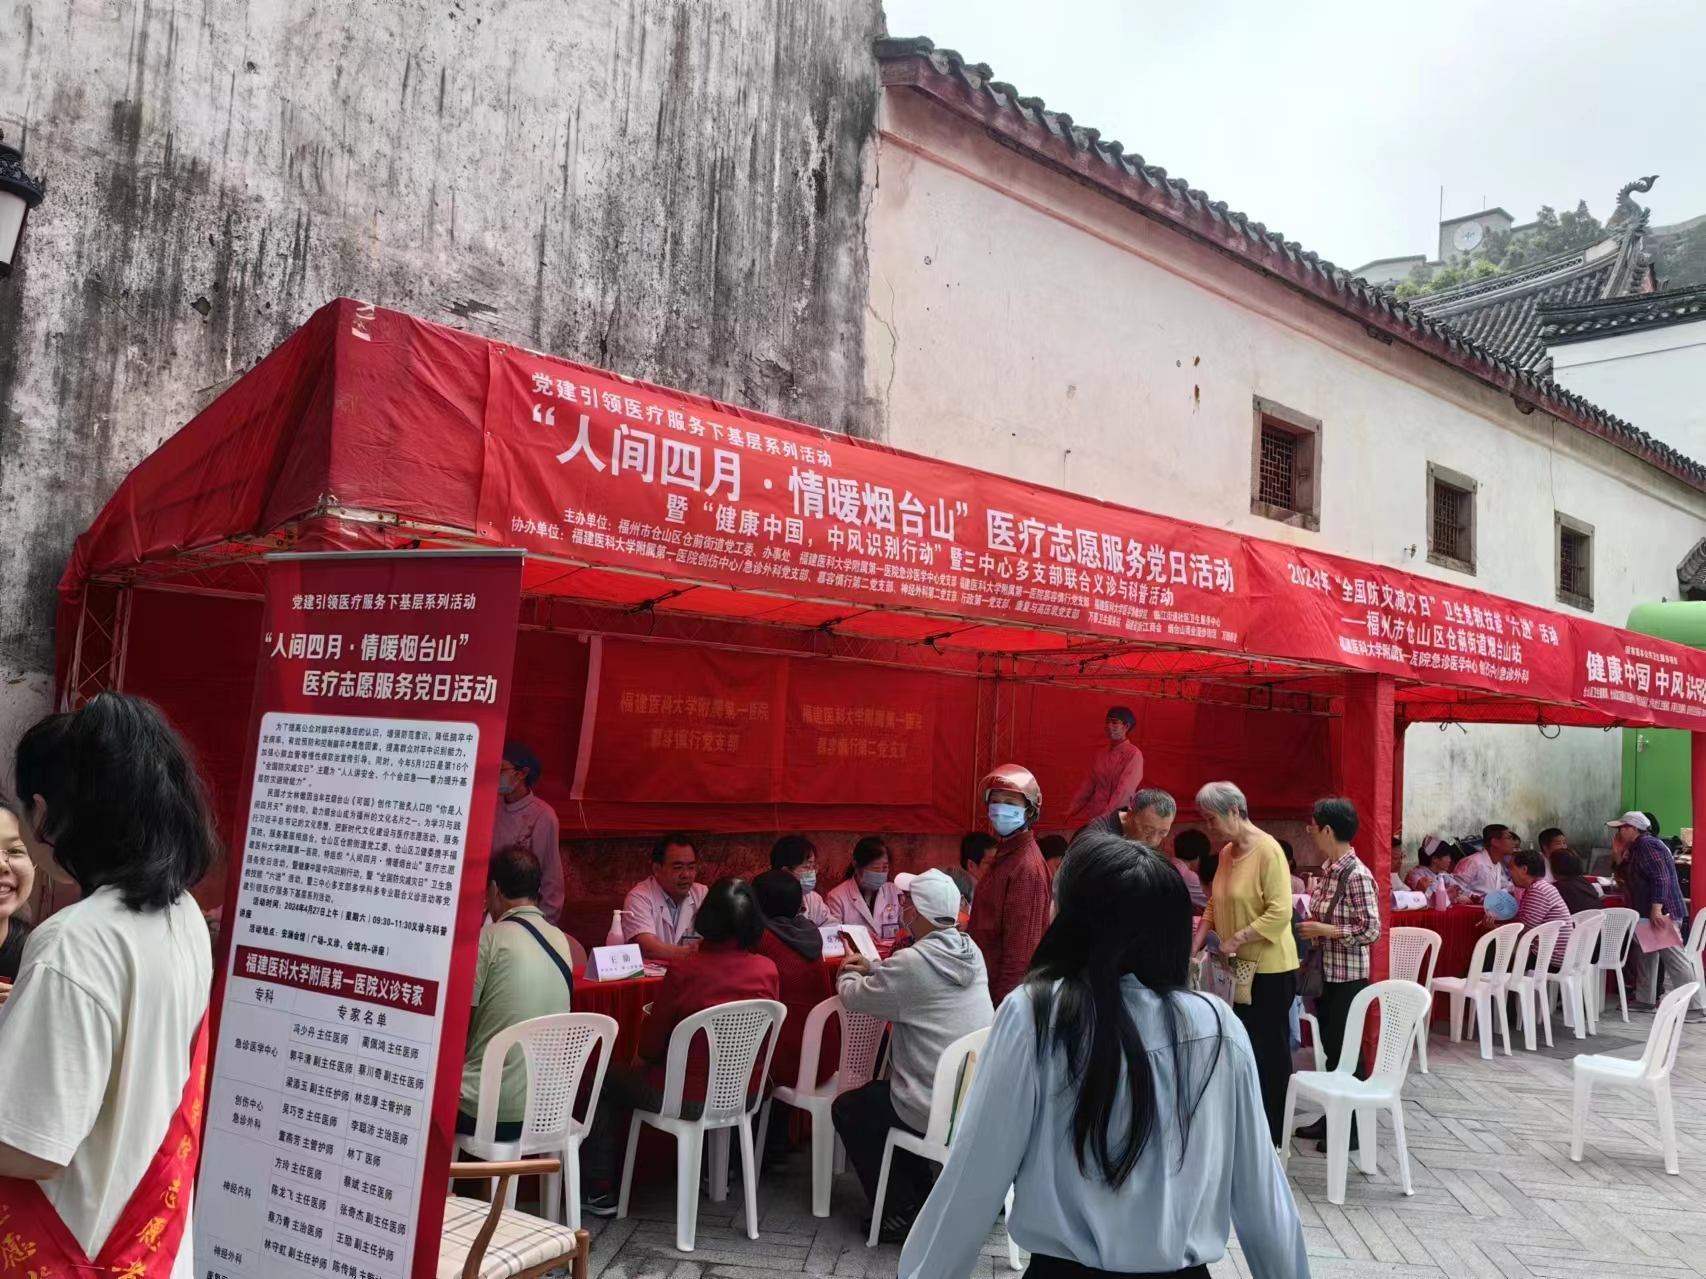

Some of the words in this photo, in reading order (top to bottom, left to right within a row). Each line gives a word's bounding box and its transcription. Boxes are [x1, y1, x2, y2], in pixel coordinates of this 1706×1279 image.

[532, 371, 832, 467] 党建引领医疗服务下基层系列活动
[292, 593, 477, 610] 党建引领医疗服务下基层系列活动
[1586, 650, 1650, 692] 健康中国
[302, 670, 498, 704] 医疗志愿服务党日活动
[239, 909, 252, 919] 讲座
[246, 952, 424, 1007] 福建医科大学附属第一医院义诊专家
[254, 987, 274, 1003] 专科
[337, 1004, 387, 1027] 专家名单
[293, 1023, 315, 1037] 冯少丹
[317, 1029, 349, 1045] 主任医师
[234, 1037, 278, 1057] 急诊医学中心
[387, 1042, 419, 1060] 主任医师
[312, 1055, 353, 1074] 副主任医师
[383, 1070, 425, 1090] 副主任医师
[309, 1082, 350, 1102] 副主任护师
[234, 1094, 263, 1111] 创伤中心
[380, 1099, 412, 1117] 主管护师
[232, 1112, 261, 1130] 急诊外科
[305, 1109, 338, 1127] 主任医师
[302, 1137, 334, 1155] 主管护师
[376, 1127, 409, 1146] 主治医师
[347, 1147, 364, 1161] 林丁
[364, 1152, 381, 1167] 医师
[291, 1162, 322, 1180] 主任医师
[222, 1180, 252, 1199] 神经内科
[270, 1183, 294, 1202] 陈龙飞
[295, 1191, 327, 1211] 主任医师
[361, 1181, 393, 1200] 主任医师
[291, 1219, 324, 1239] 主治医师
[365, 1211, 407, 1236] 副主任医师
[213, 1244, 243, 1265] 神经外科
[287, 1246, 328, 1271] 副主任护师
[353, 1237, 395, 1262] 副主任护师
